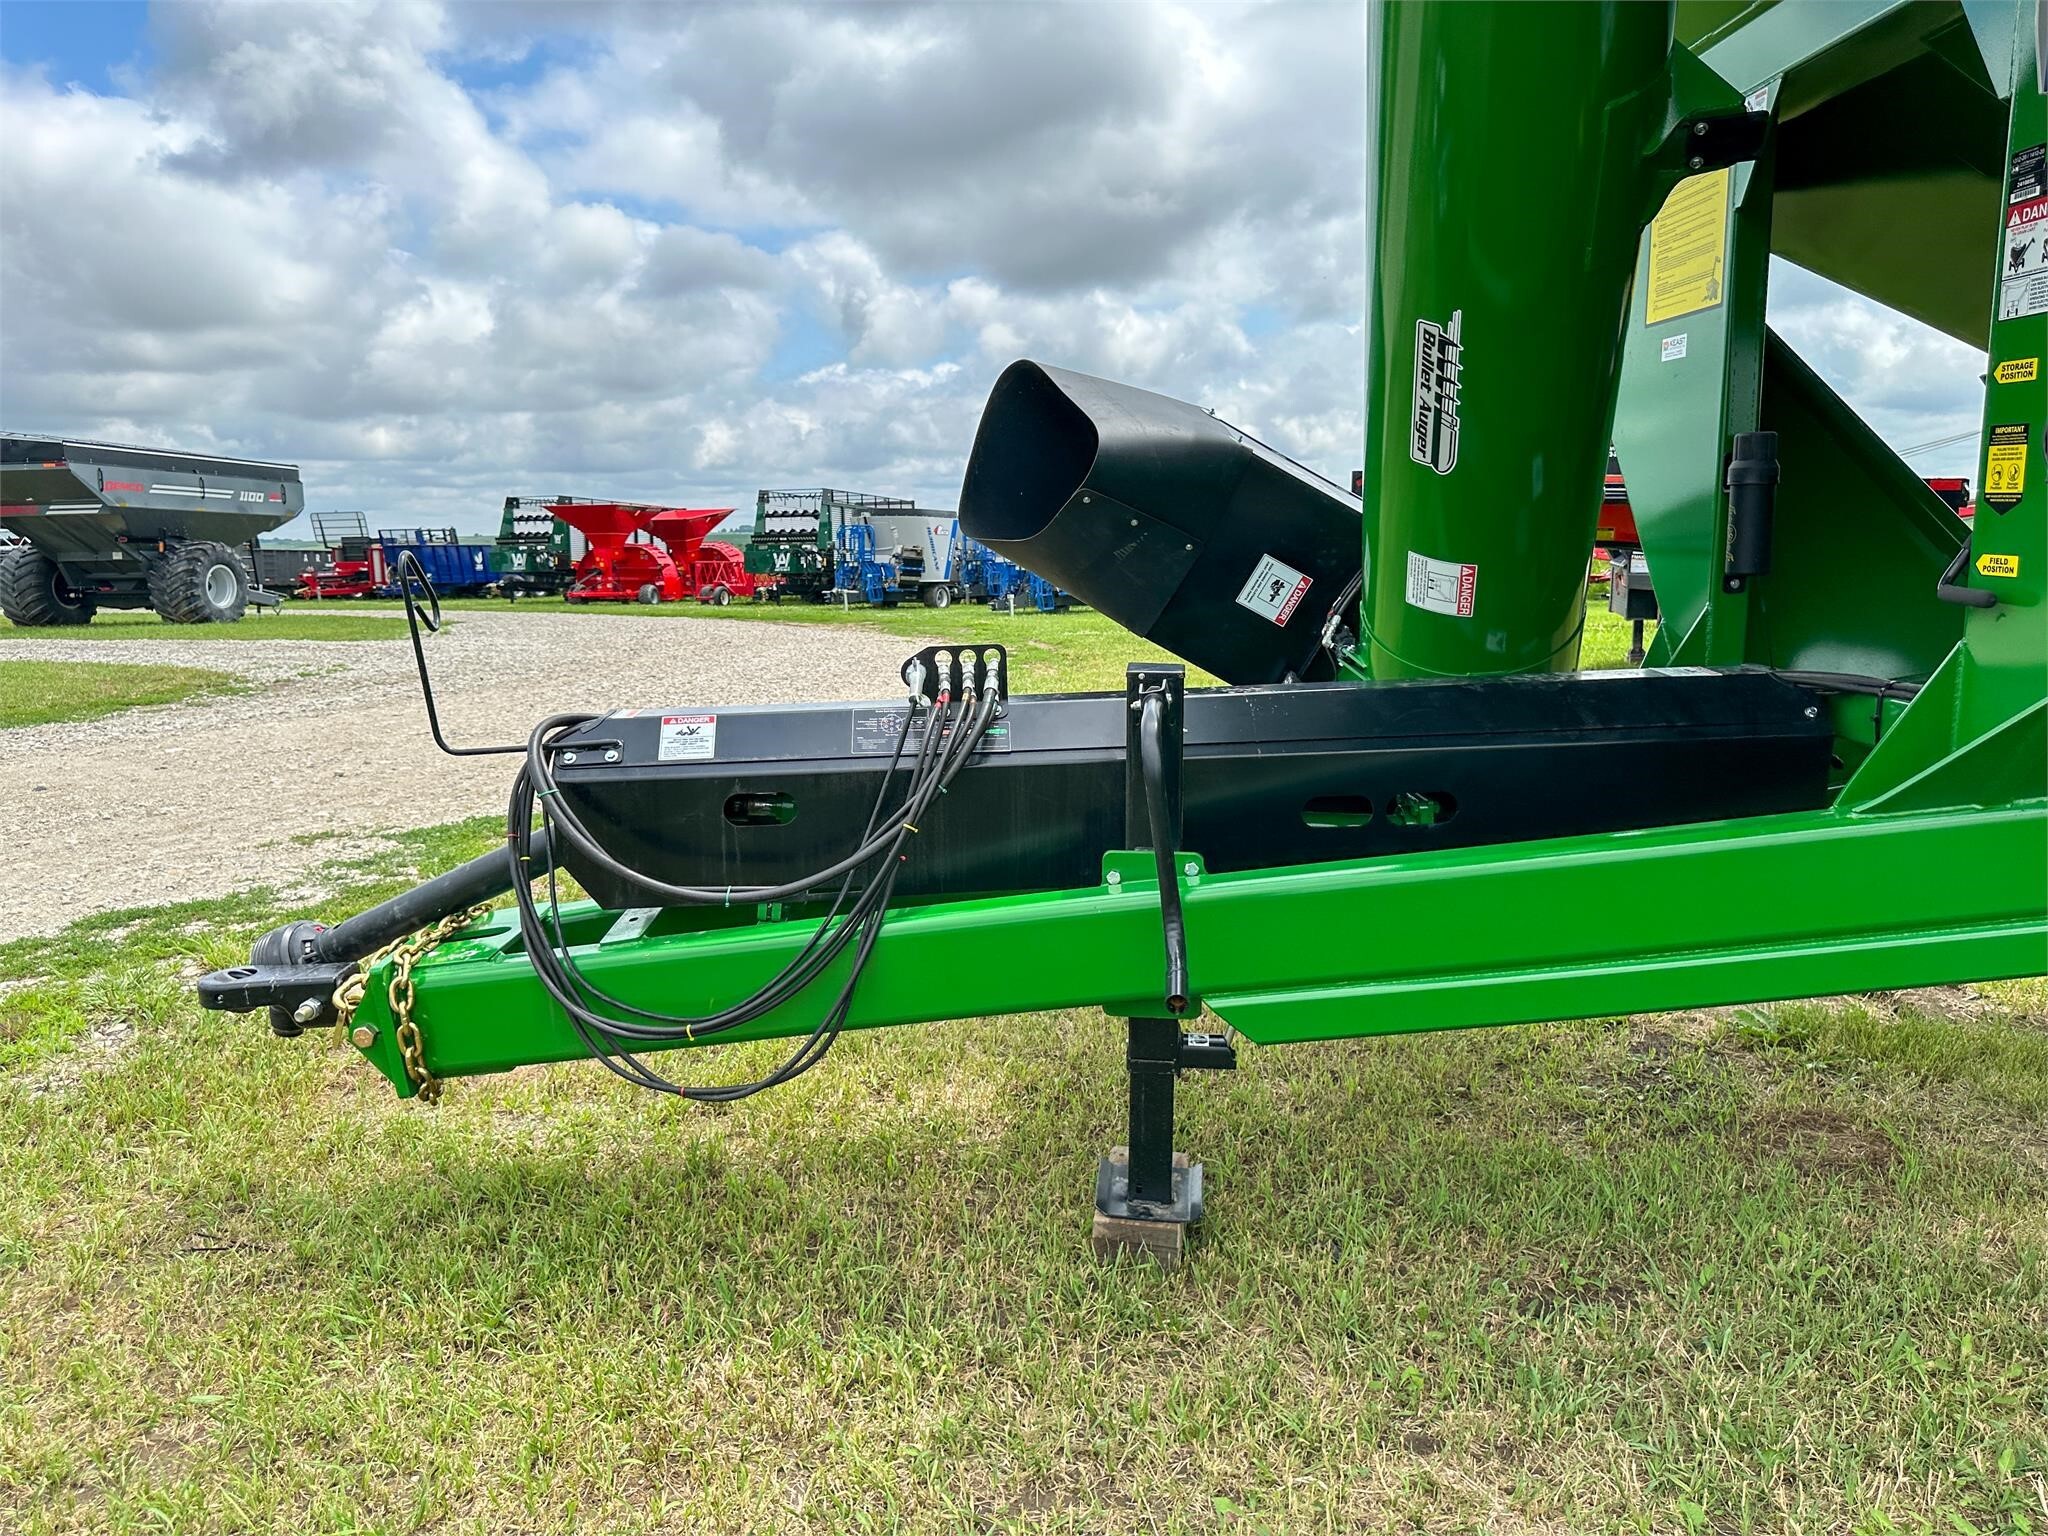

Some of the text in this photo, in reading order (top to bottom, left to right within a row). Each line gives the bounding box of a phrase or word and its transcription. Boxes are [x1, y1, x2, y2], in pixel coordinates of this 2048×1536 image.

[2001, 361, 2034, 373] STORAGE
[2000, 370, 2034, 381] POSITION
[1415, 328, 1436, 459] Bullet Auger
[1995, 425, 2025, 435] IMPORTANT
[239, 490, 265, 503] 1100
[1989, 557, 2009, 566] FIELD
[1982, 565, 2015, 574] POSITION
[1458, 576, 1474, 616] DANGER
[1278, 590, 1302, 621] DANGER
[677, 716, 711, 725] DANGER
